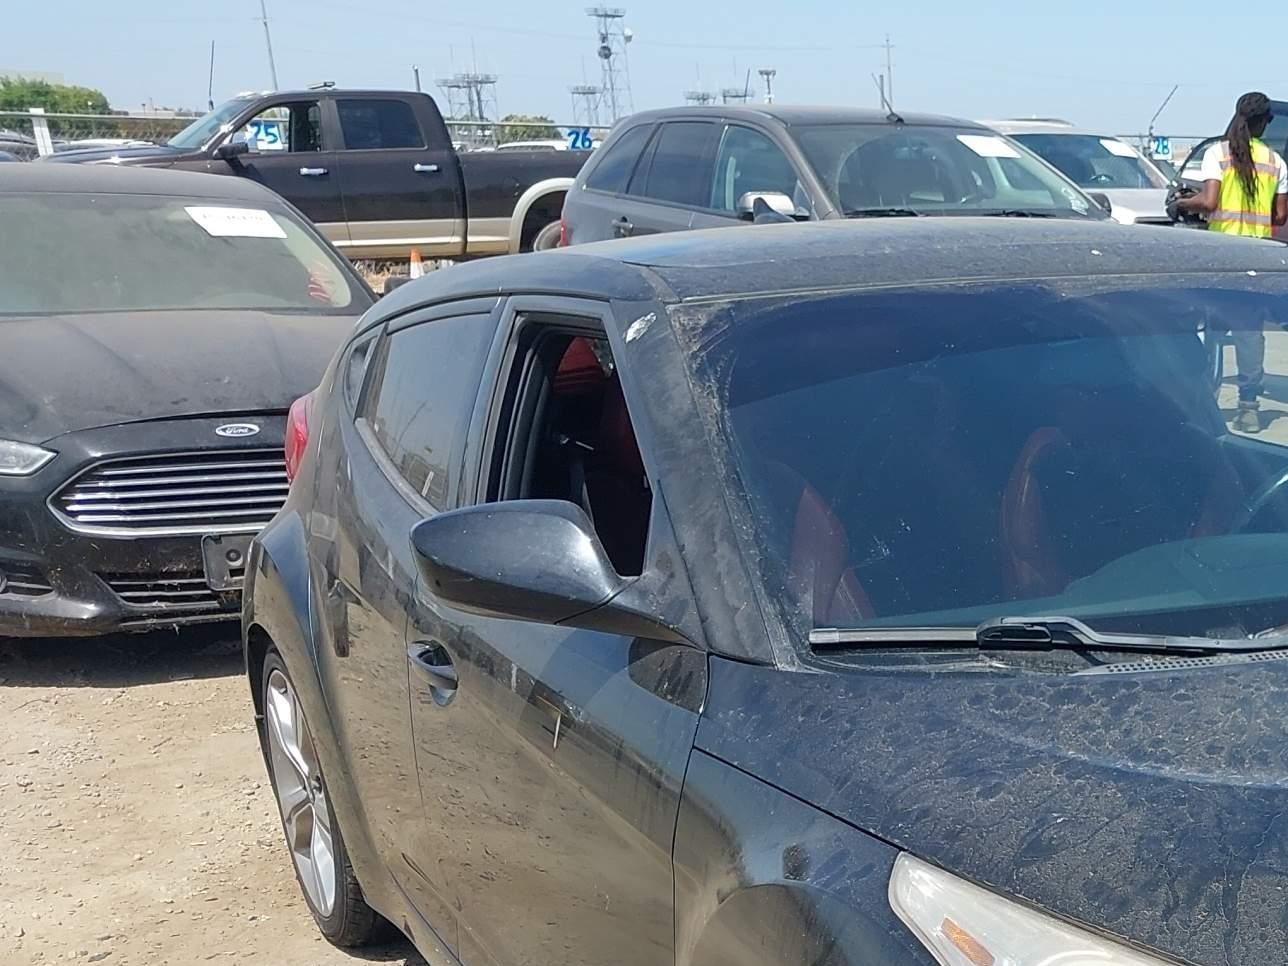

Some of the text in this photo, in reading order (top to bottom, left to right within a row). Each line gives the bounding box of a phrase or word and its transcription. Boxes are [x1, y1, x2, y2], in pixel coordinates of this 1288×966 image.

[249, 121, 279, 144] 25
[567, 127, 593, 149] 26
[1153, 136, 1170, 155] 28
